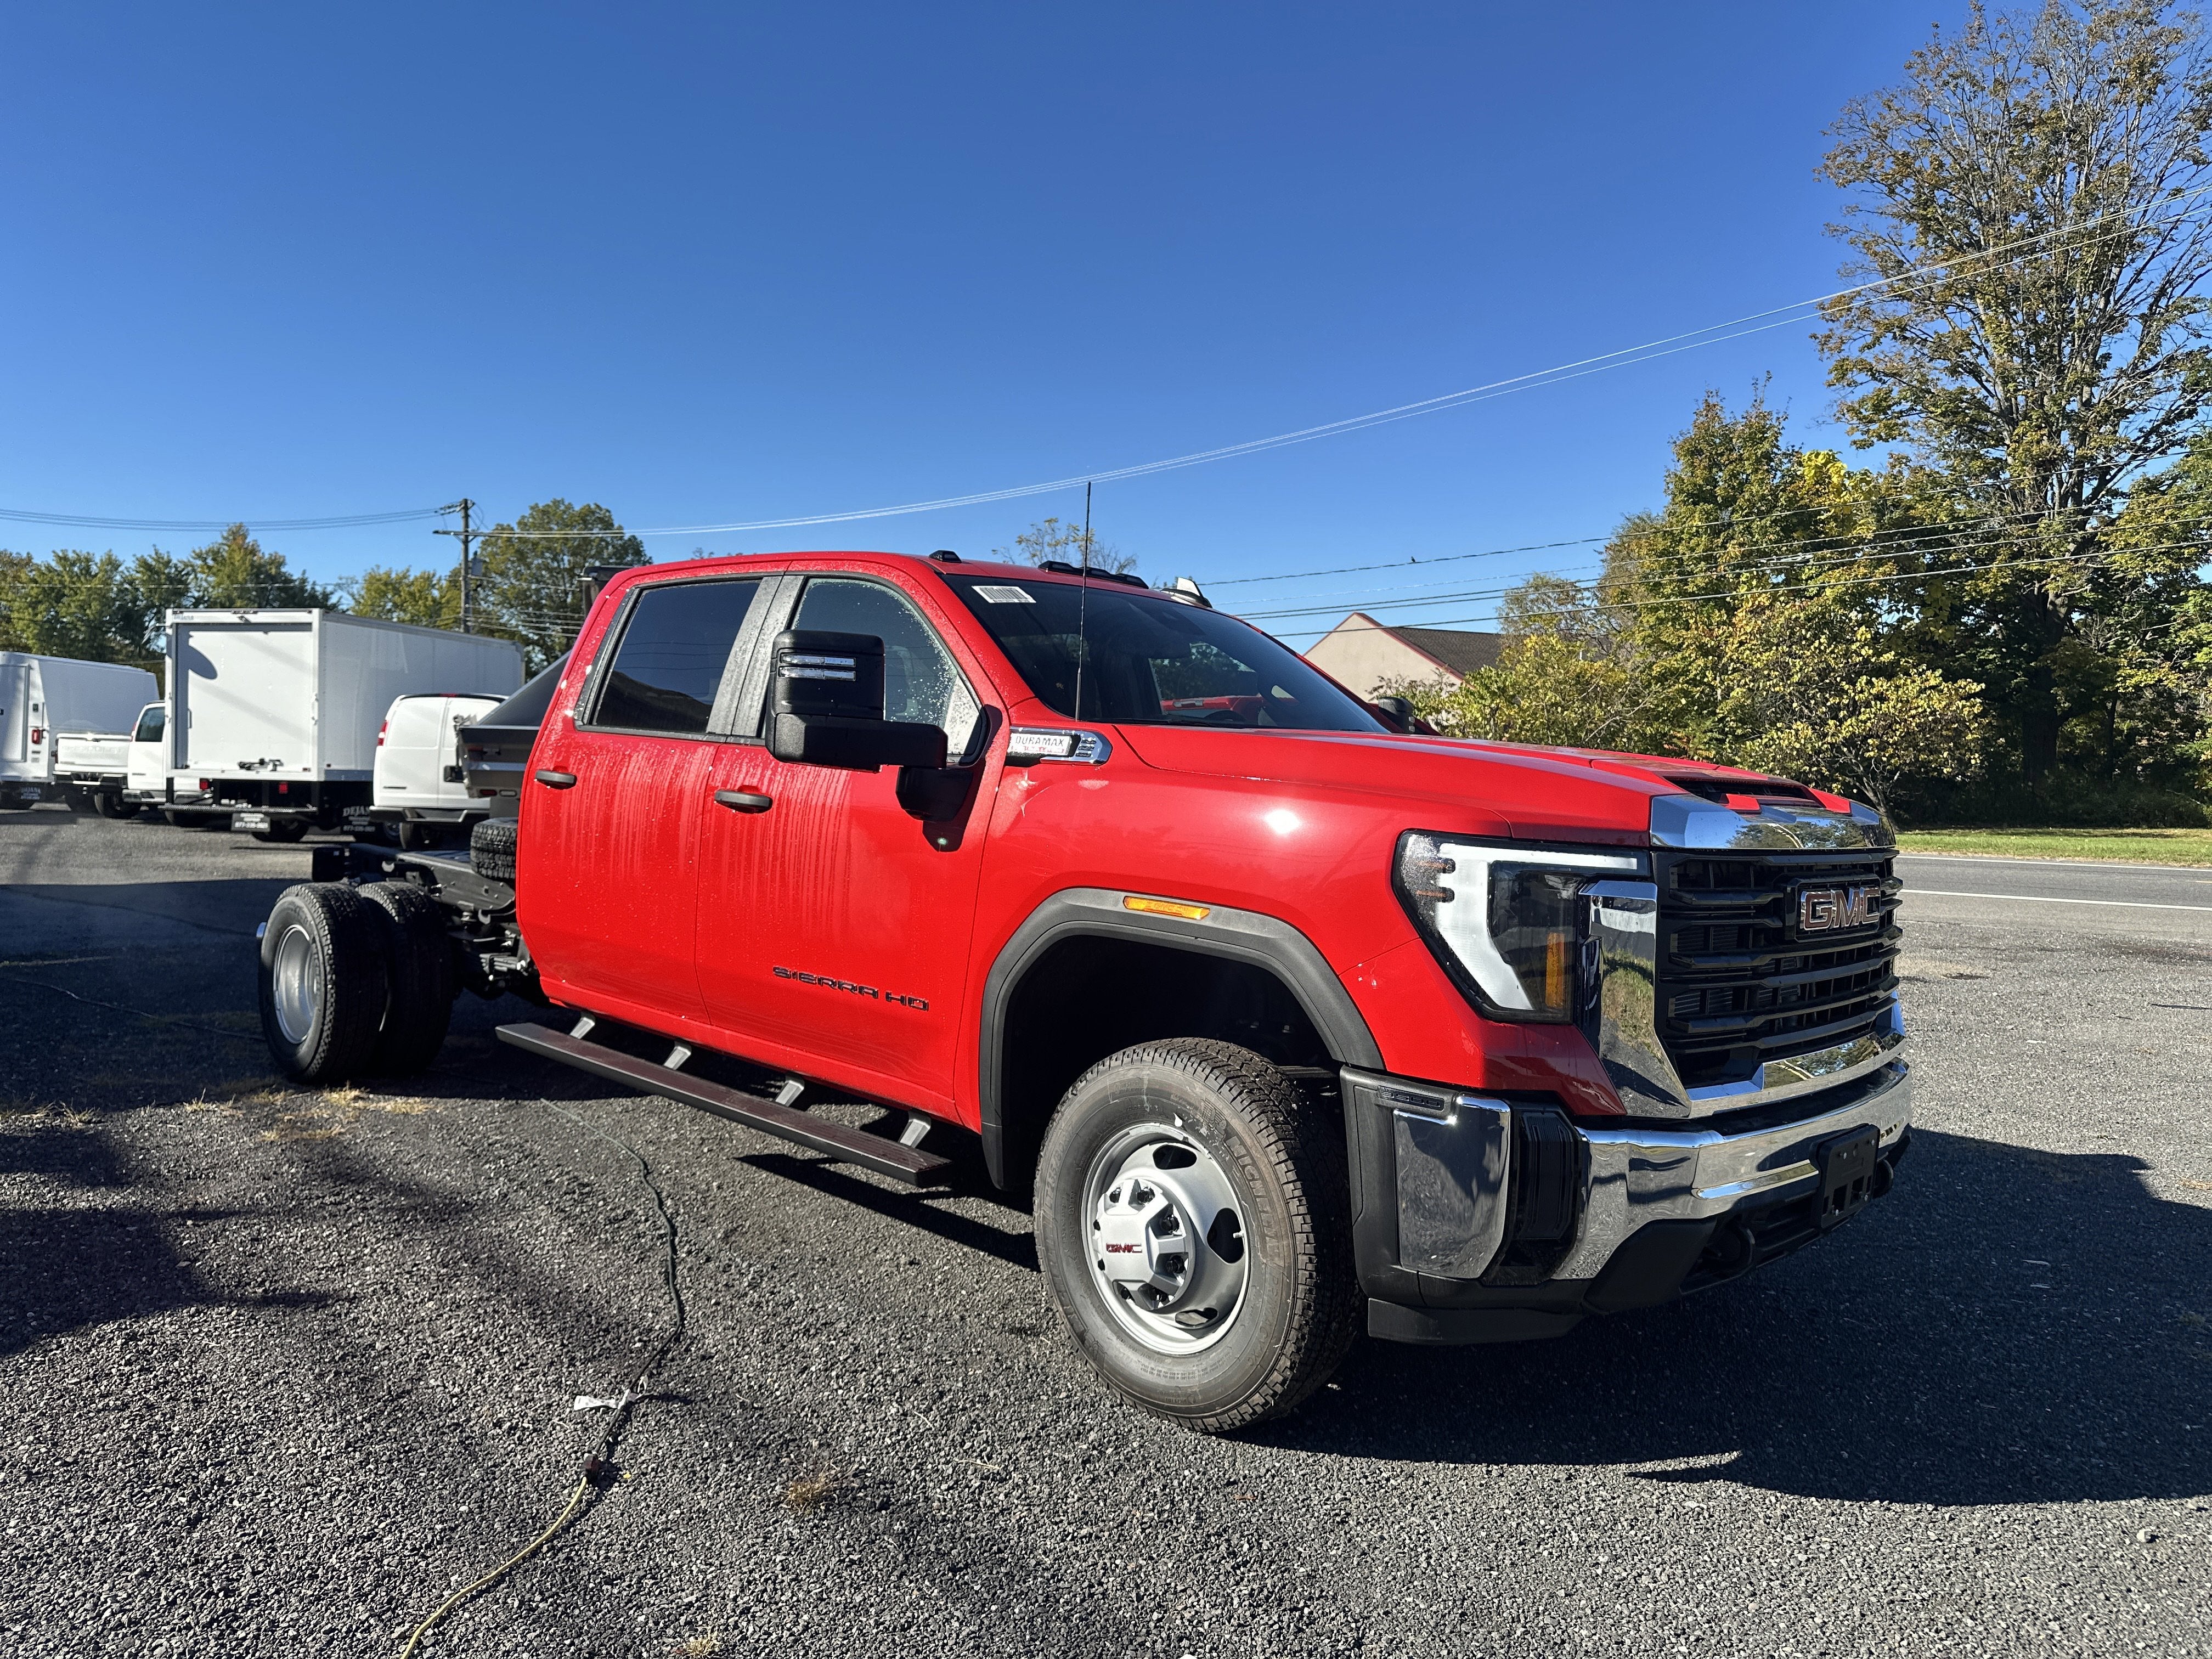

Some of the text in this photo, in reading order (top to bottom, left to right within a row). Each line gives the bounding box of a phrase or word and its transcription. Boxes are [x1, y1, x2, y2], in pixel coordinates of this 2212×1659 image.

[1015, 735, 1065, 747] DURAMAX
[1800, 887, 1881, 931] GMC
[772, 966, 929, 1011] SIERRA HD
[1224, 1133, 1280, 1259] MICHELIN
[1105, 1243, 1143, 1253] GMC
